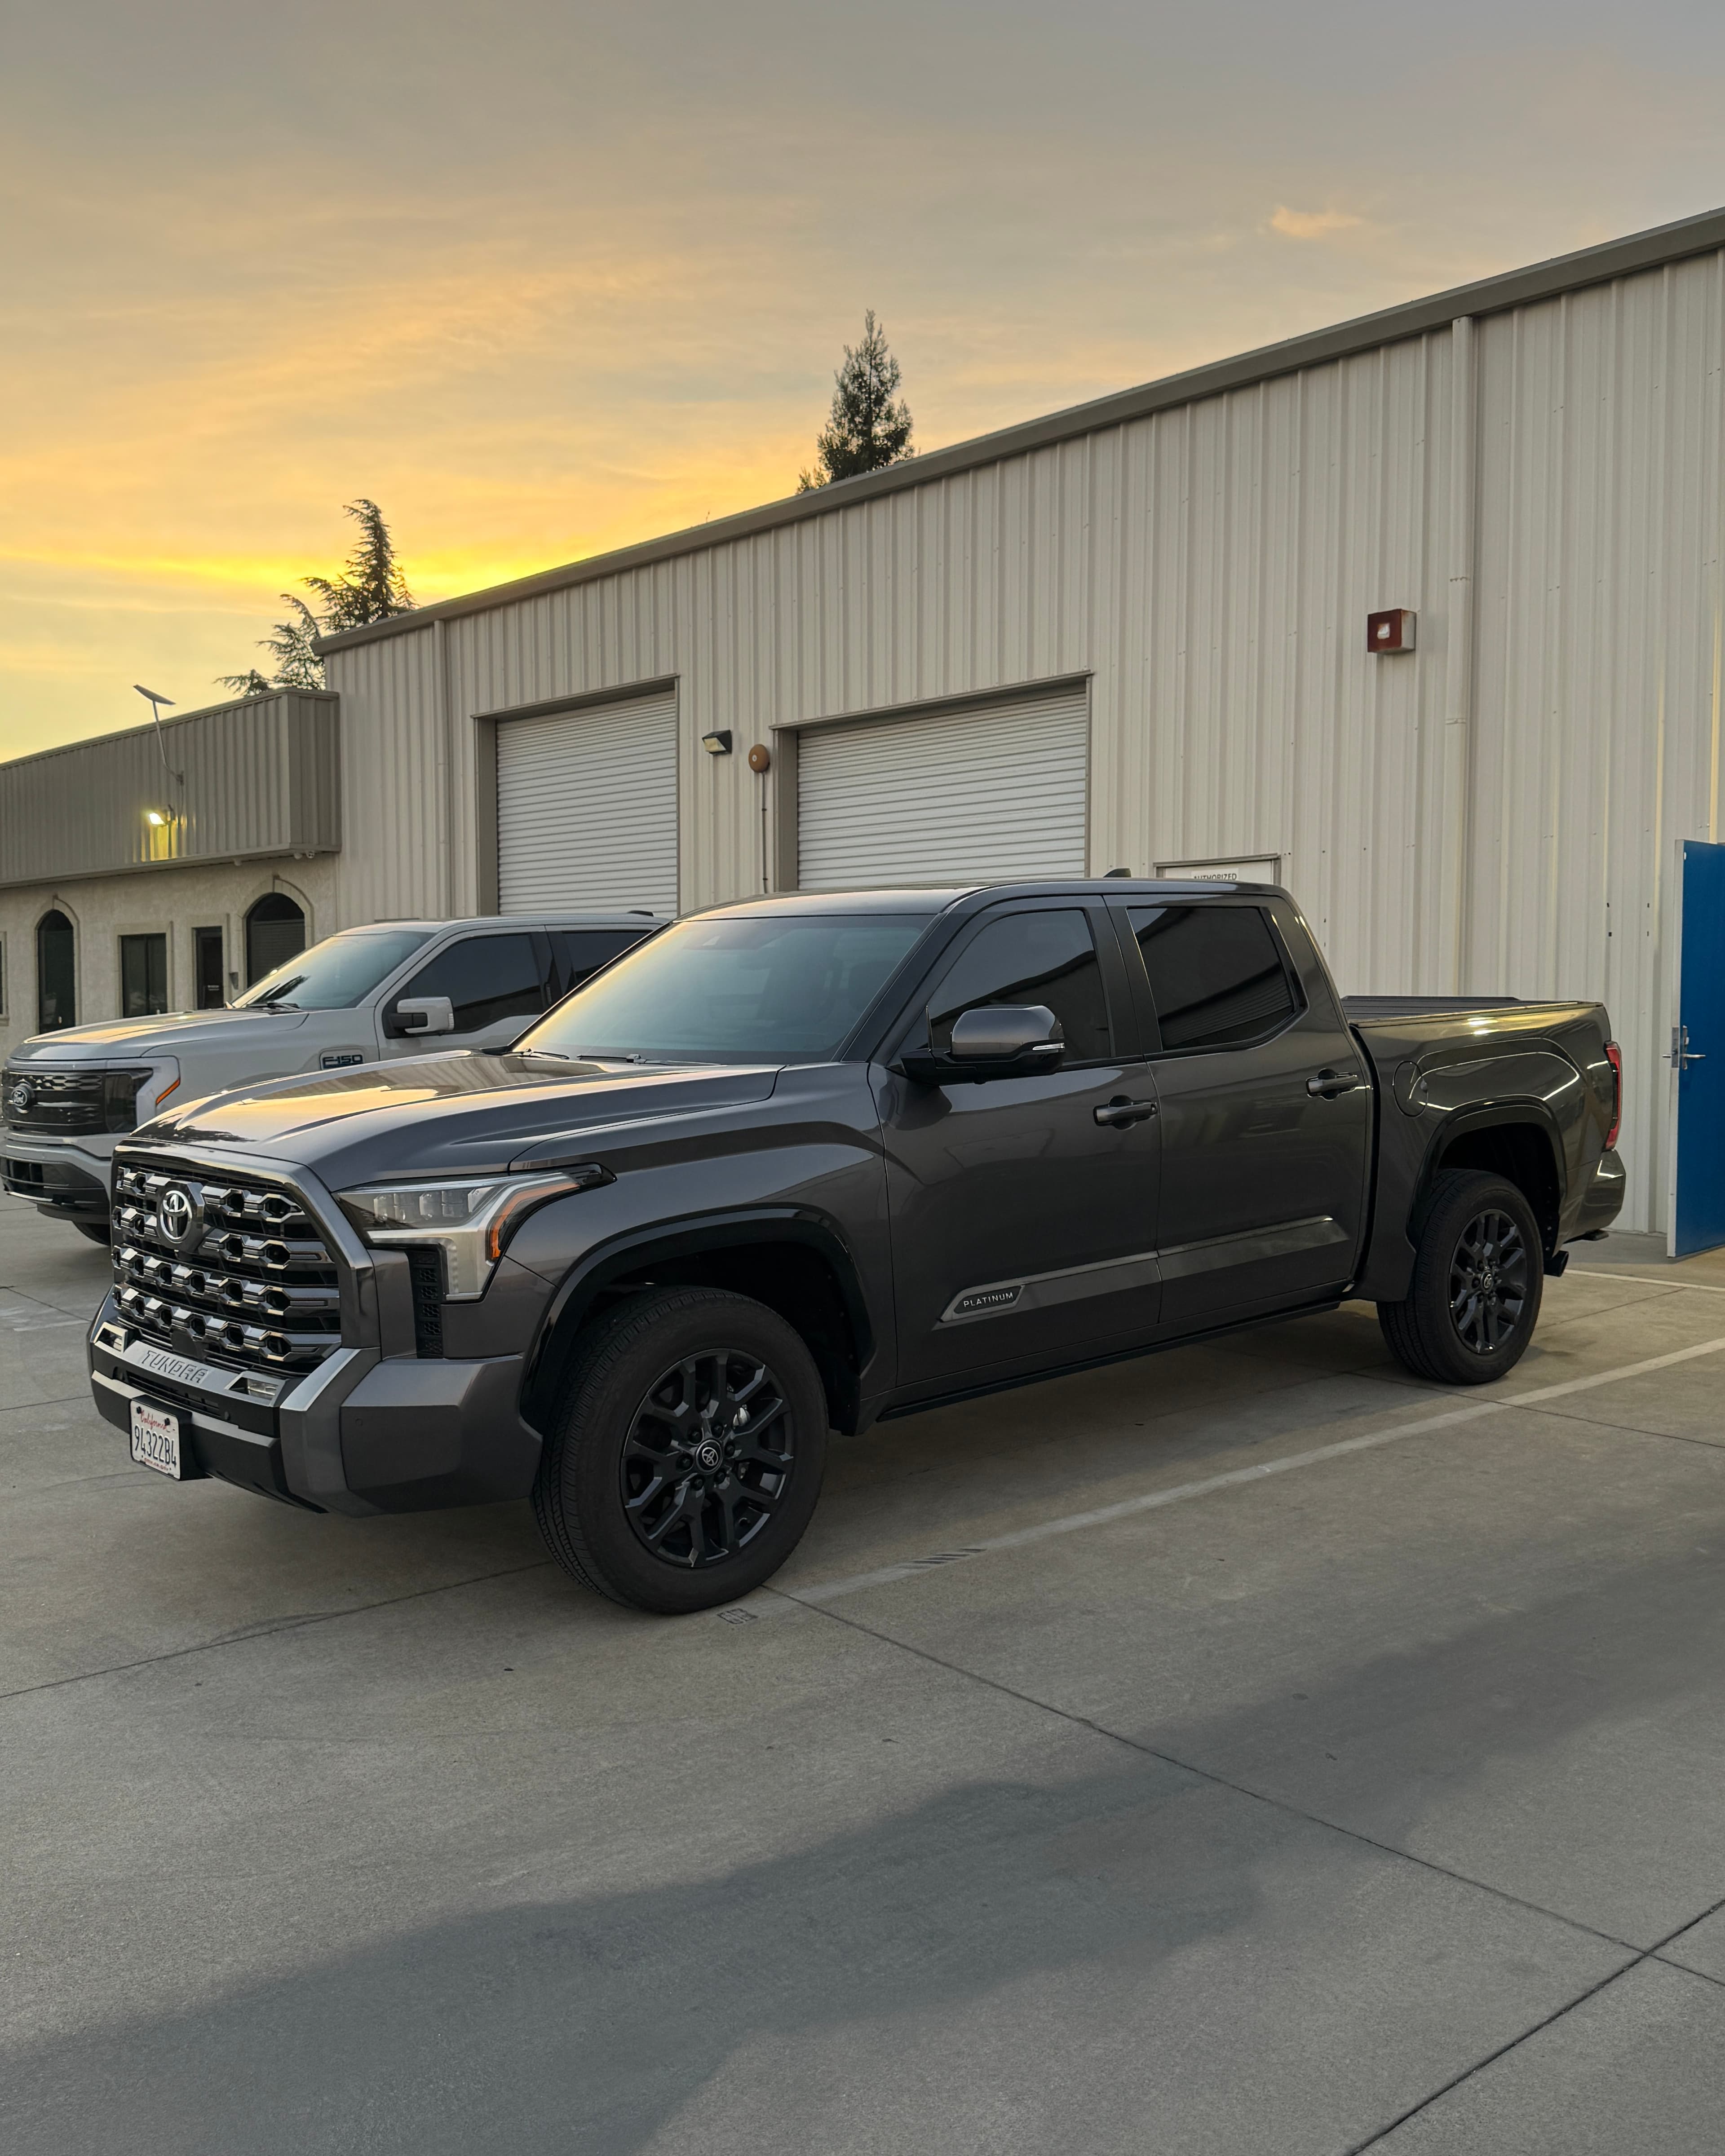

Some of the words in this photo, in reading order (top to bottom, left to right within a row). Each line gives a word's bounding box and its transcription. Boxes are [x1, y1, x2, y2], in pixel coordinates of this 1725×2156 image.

[323, 1055, 363, 1065] F-150
[964, 1292, 1013, 1308] PLATINUM
[141, 1350, 208, 1383] TUNDRA
[135, 1425, 177, 1467] 94322B4
